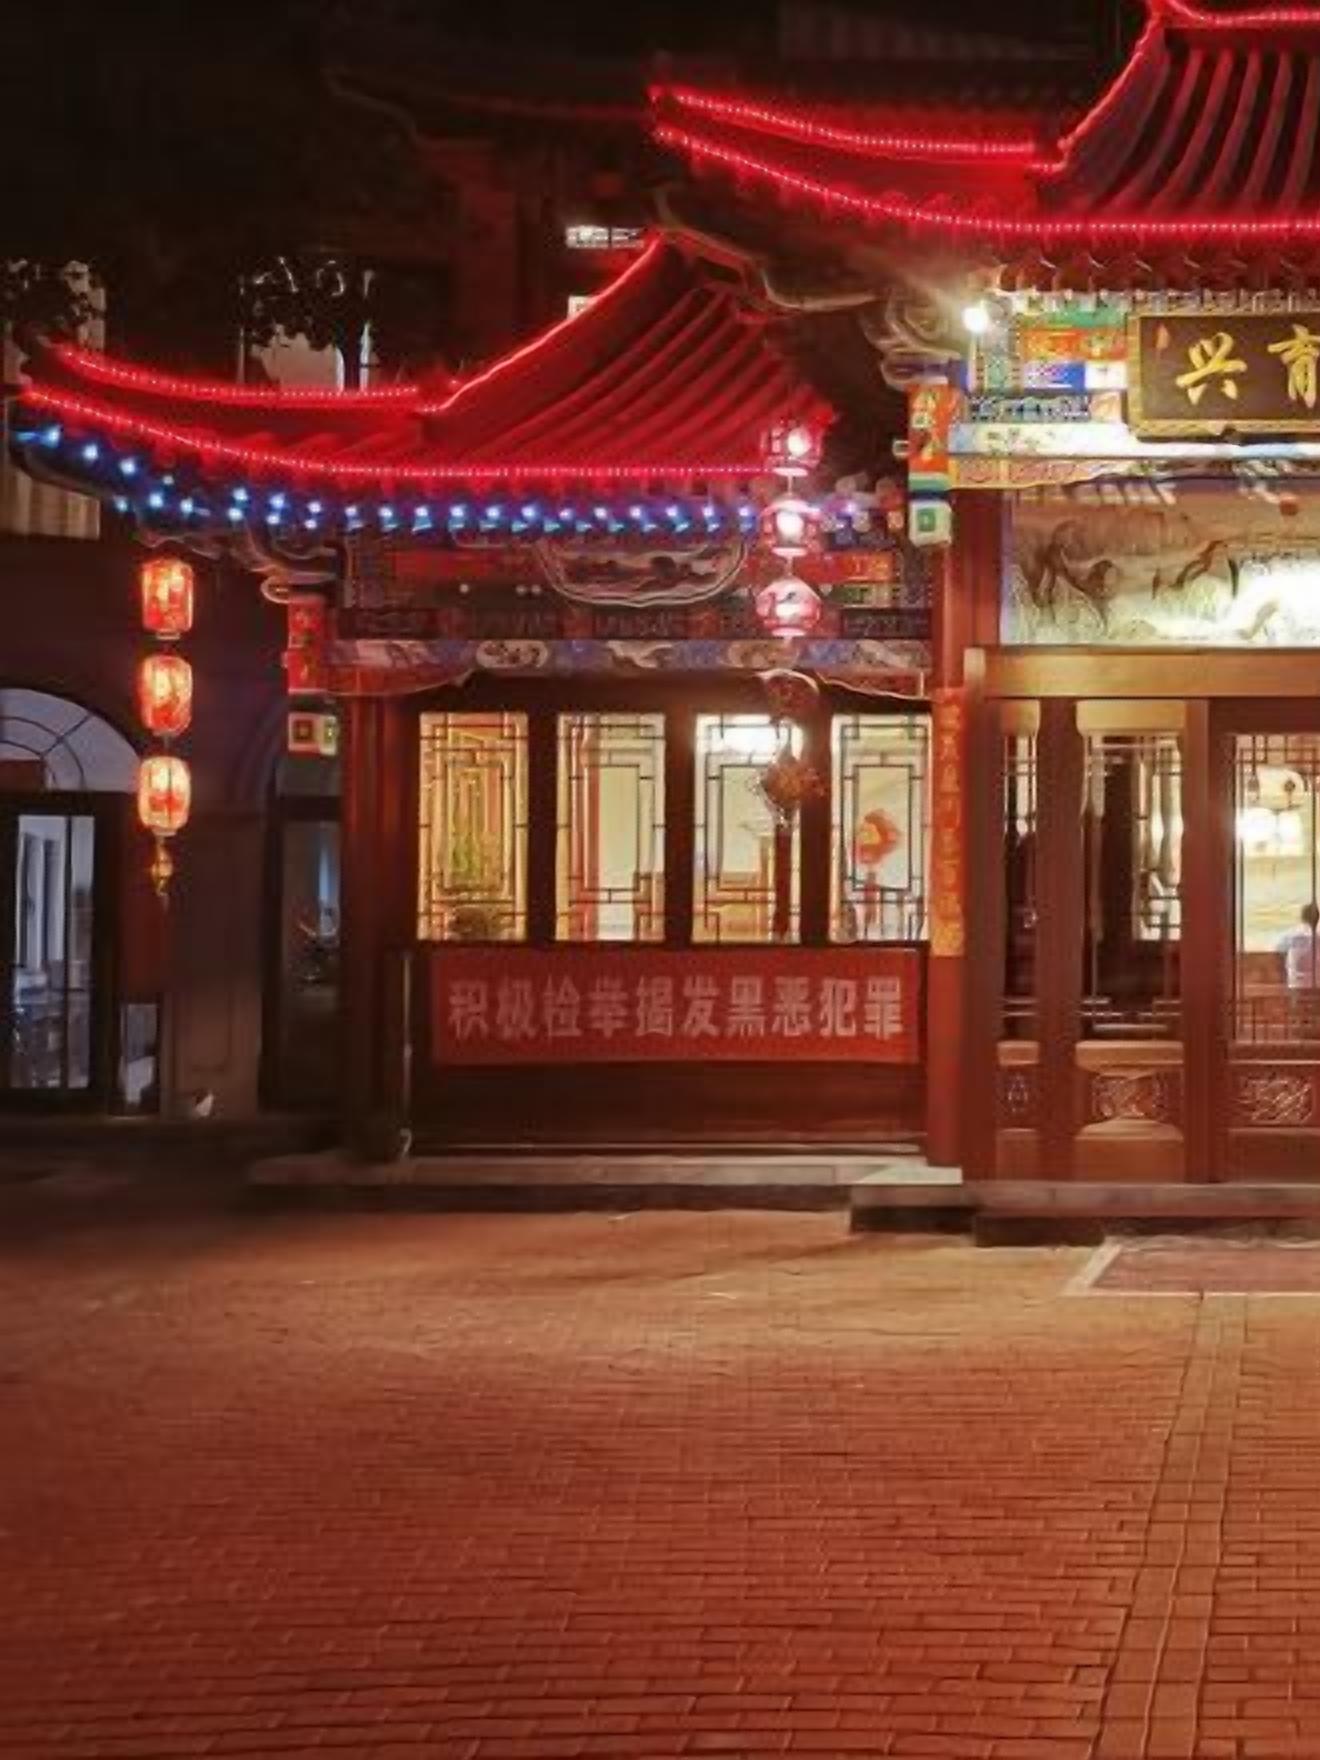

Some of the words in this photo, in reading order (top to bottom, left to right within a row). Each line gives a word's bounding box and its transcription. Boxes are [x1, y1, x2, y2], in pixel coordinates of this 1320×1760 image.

[448, 974, 904, 1040] 积极检举揭发黑恶犯罪
